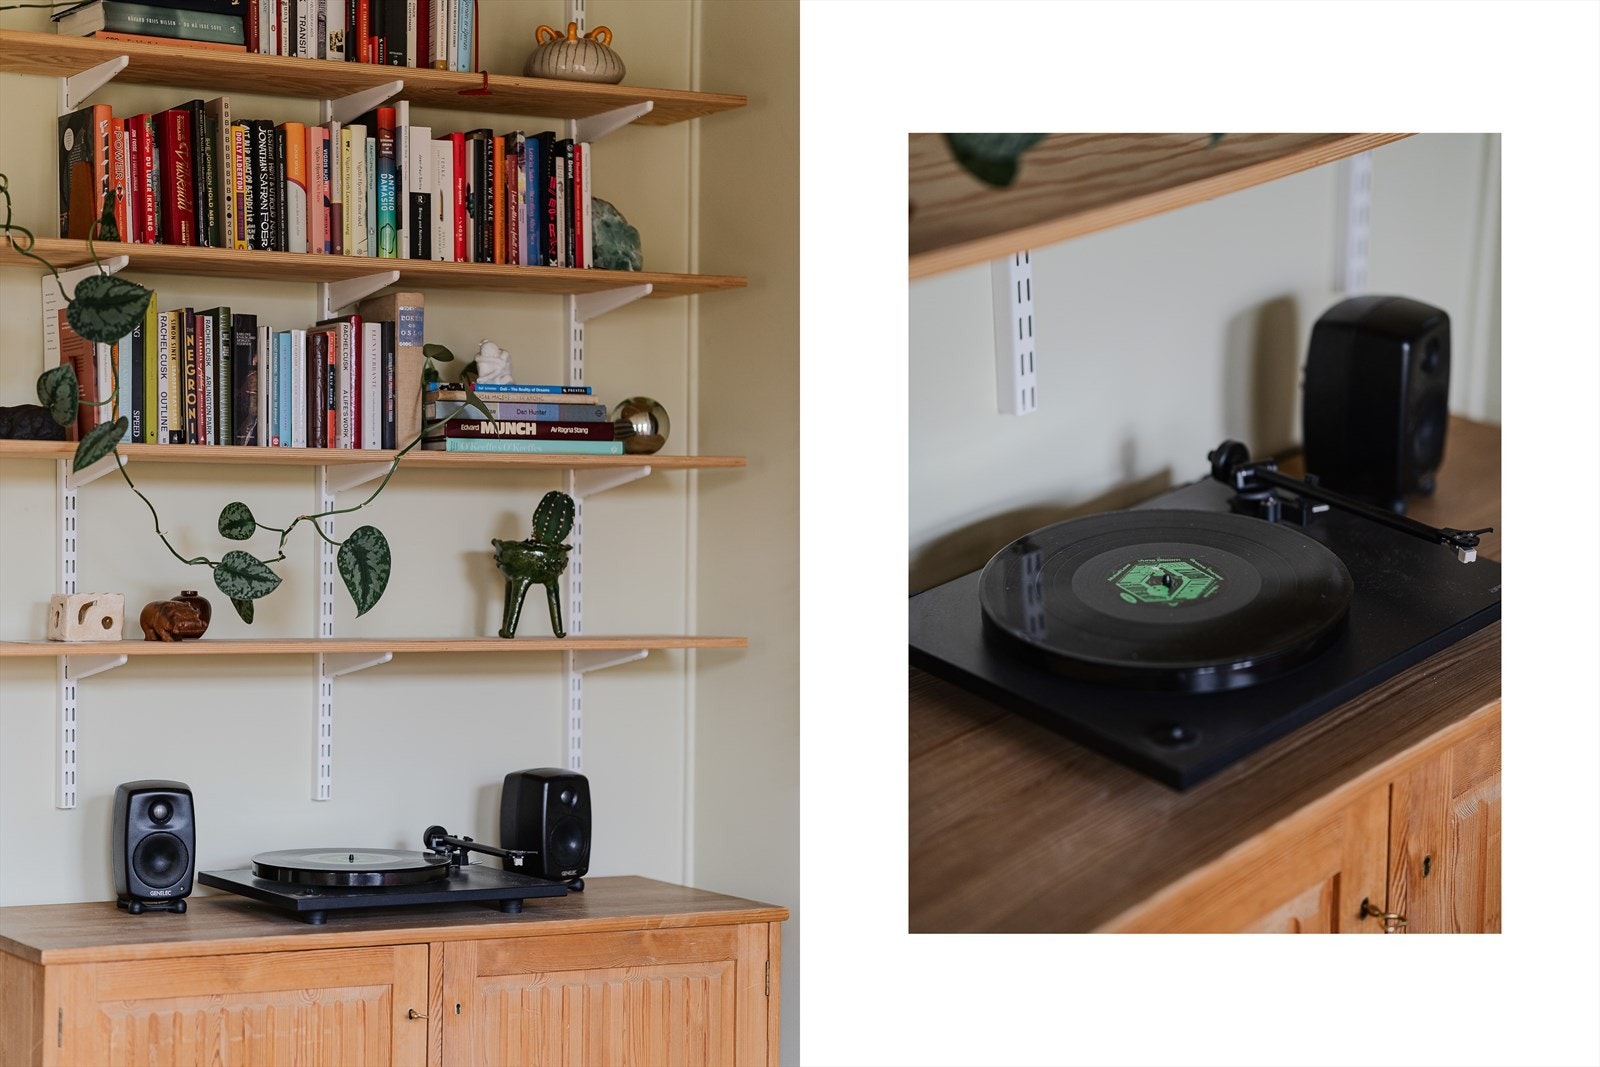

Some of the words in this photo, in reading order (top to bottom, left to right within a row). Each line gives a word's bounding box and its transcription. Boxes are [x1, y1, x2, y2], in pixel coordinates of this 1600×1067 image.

[299, 14, 307, 55] TRANSIT
[114, 130, 125, 181] POWER
[235, 131, 243, 153] DOLLY
[258, 125, 268, 172] JONATHAN
[145, 156, 152, 167] DU
[235, 154, 244, 191] ALDERTON
[259, 173, 269, 210] SAFRAN
[380, 173, 388, 212] DAMASIO
[487, 187, 494, 200] WE
[528, 189, 536, 217] Scrolling
[260, 212, 270, 248] FOER
[160, 315, 168, 353] RACHEL
[160, 353, 168, 380] CUSK
[185, 334, 197, 434] NEGRONI
[160, 391, 168, 432] OUTLINE
[205, 375, 213, 417] ARLINGTON
[132, 409, 141, 437] SPEED
[480, 421, 537, 435] MUNCH
[557, 426, 574, 435] Ragna
[573, 426, 589, 435] Stang
